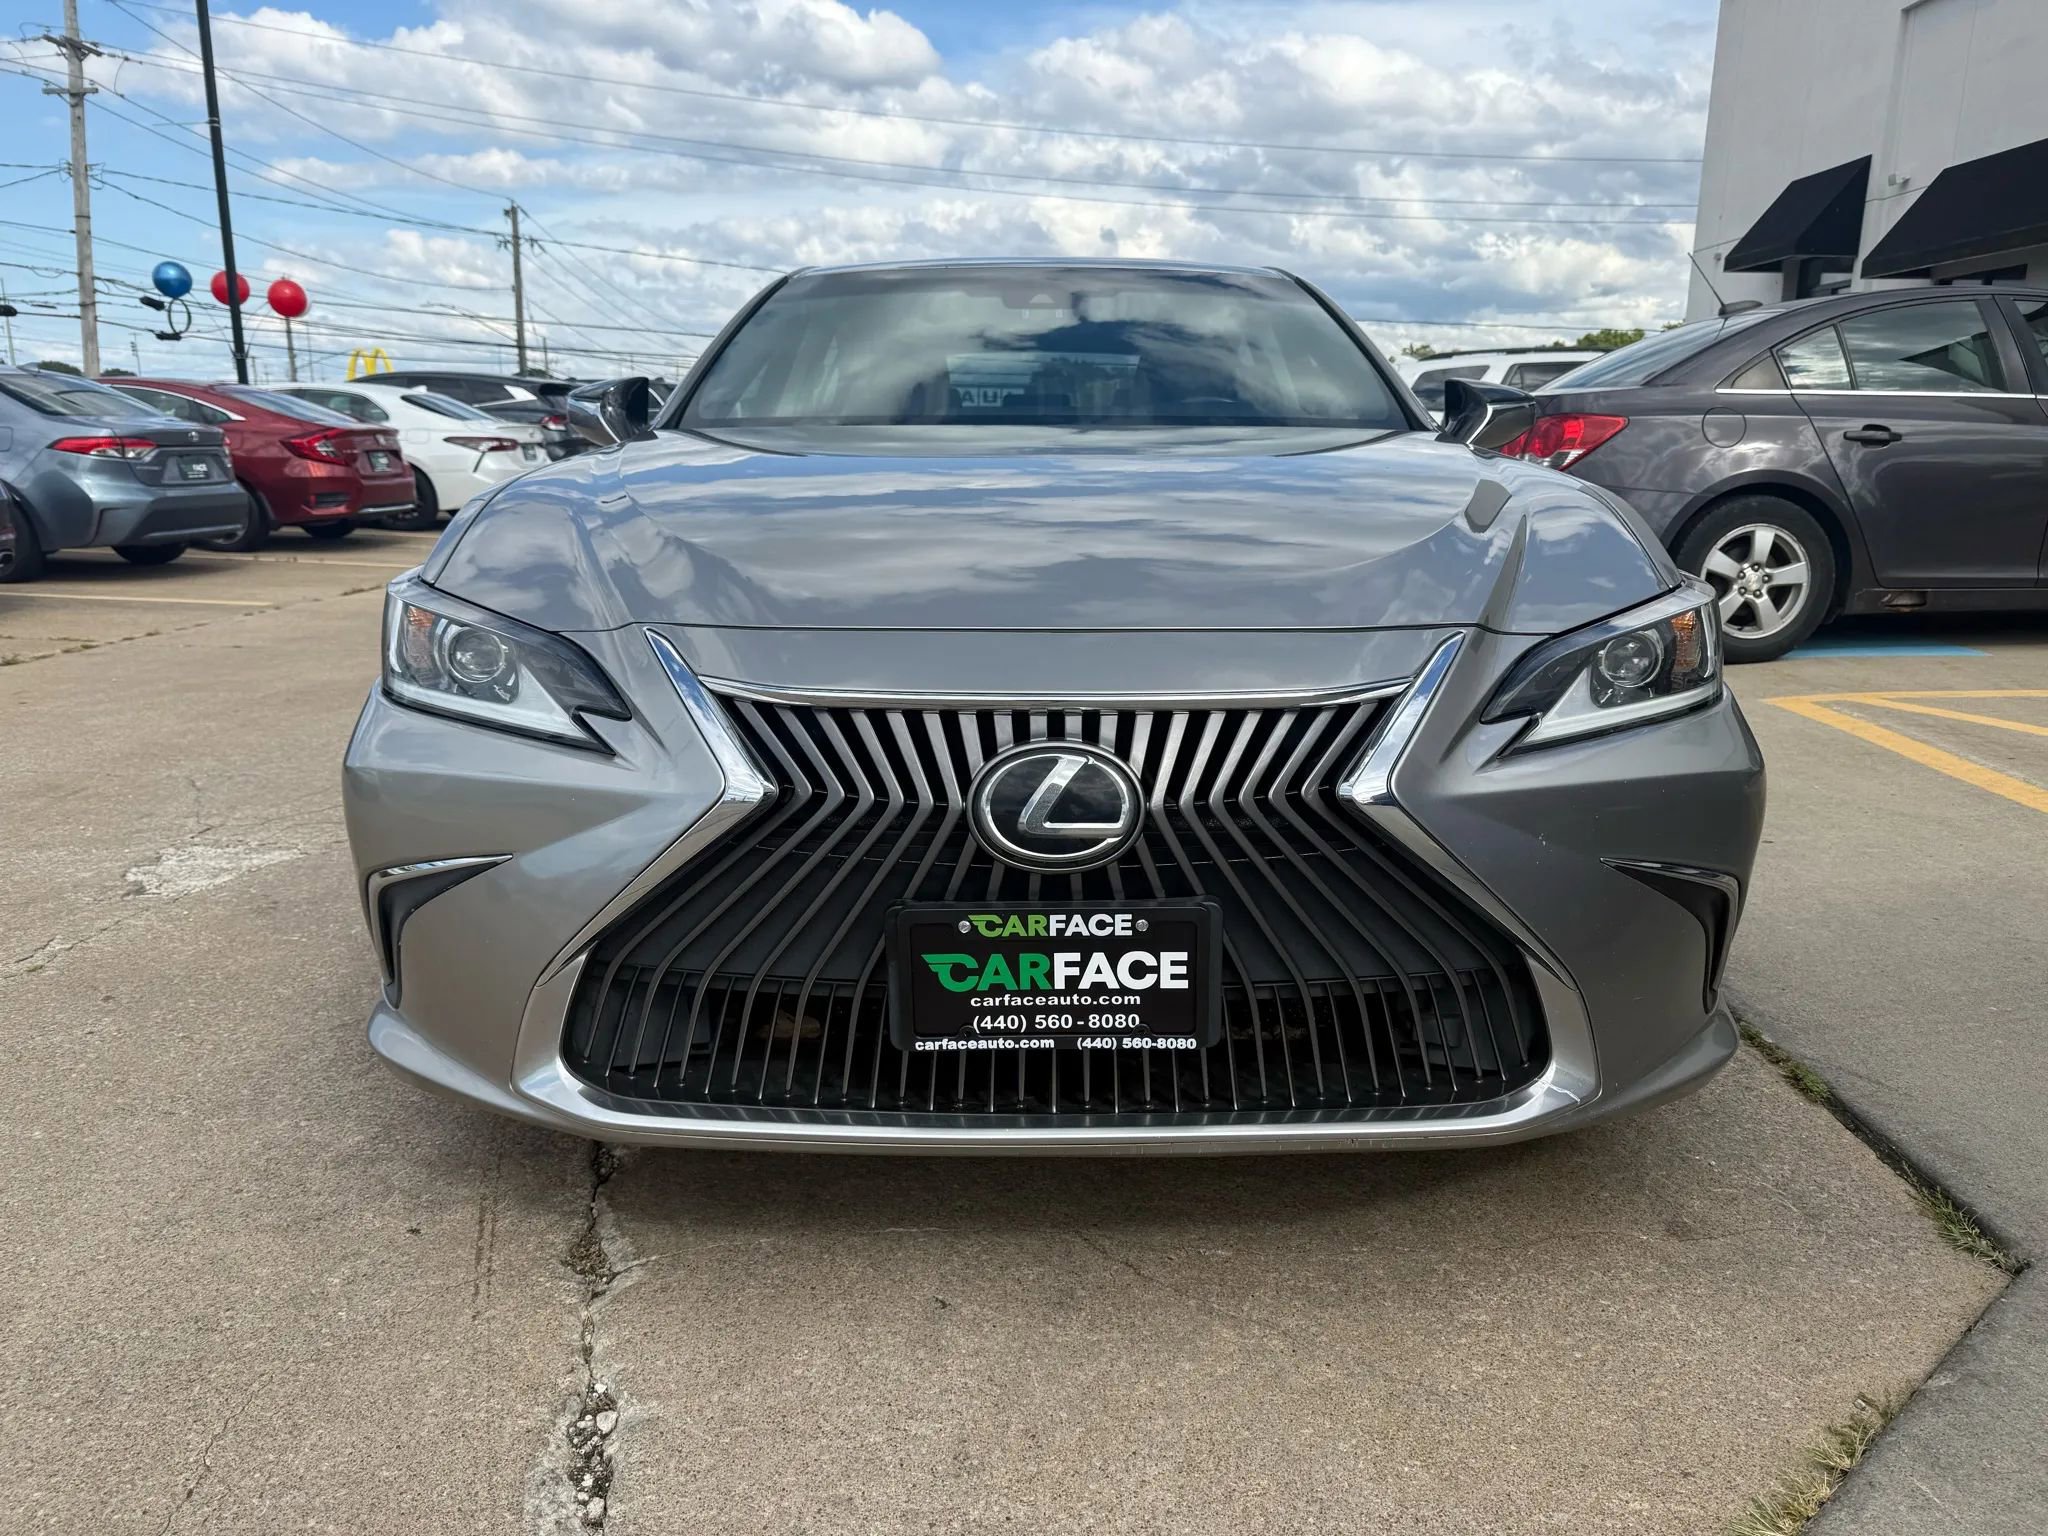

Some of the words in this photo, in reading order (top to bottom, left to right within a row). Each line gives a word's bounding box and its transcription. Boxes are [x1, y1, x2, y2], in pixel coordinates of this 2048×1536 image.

[968, 913, 1133, 937] CARFACE
[921, 951, 1189, 992] CARFACE
[970, 993, 1141, 1007] carfaceauto.com
[973, 1014, 1027, 1034] (440)
[914, 1037, 1055, 1051] carfaceauto.com
[1076, 1037, 1118, 1051] (440)
[1122, 1037, 1197, 1050] 560-8080
